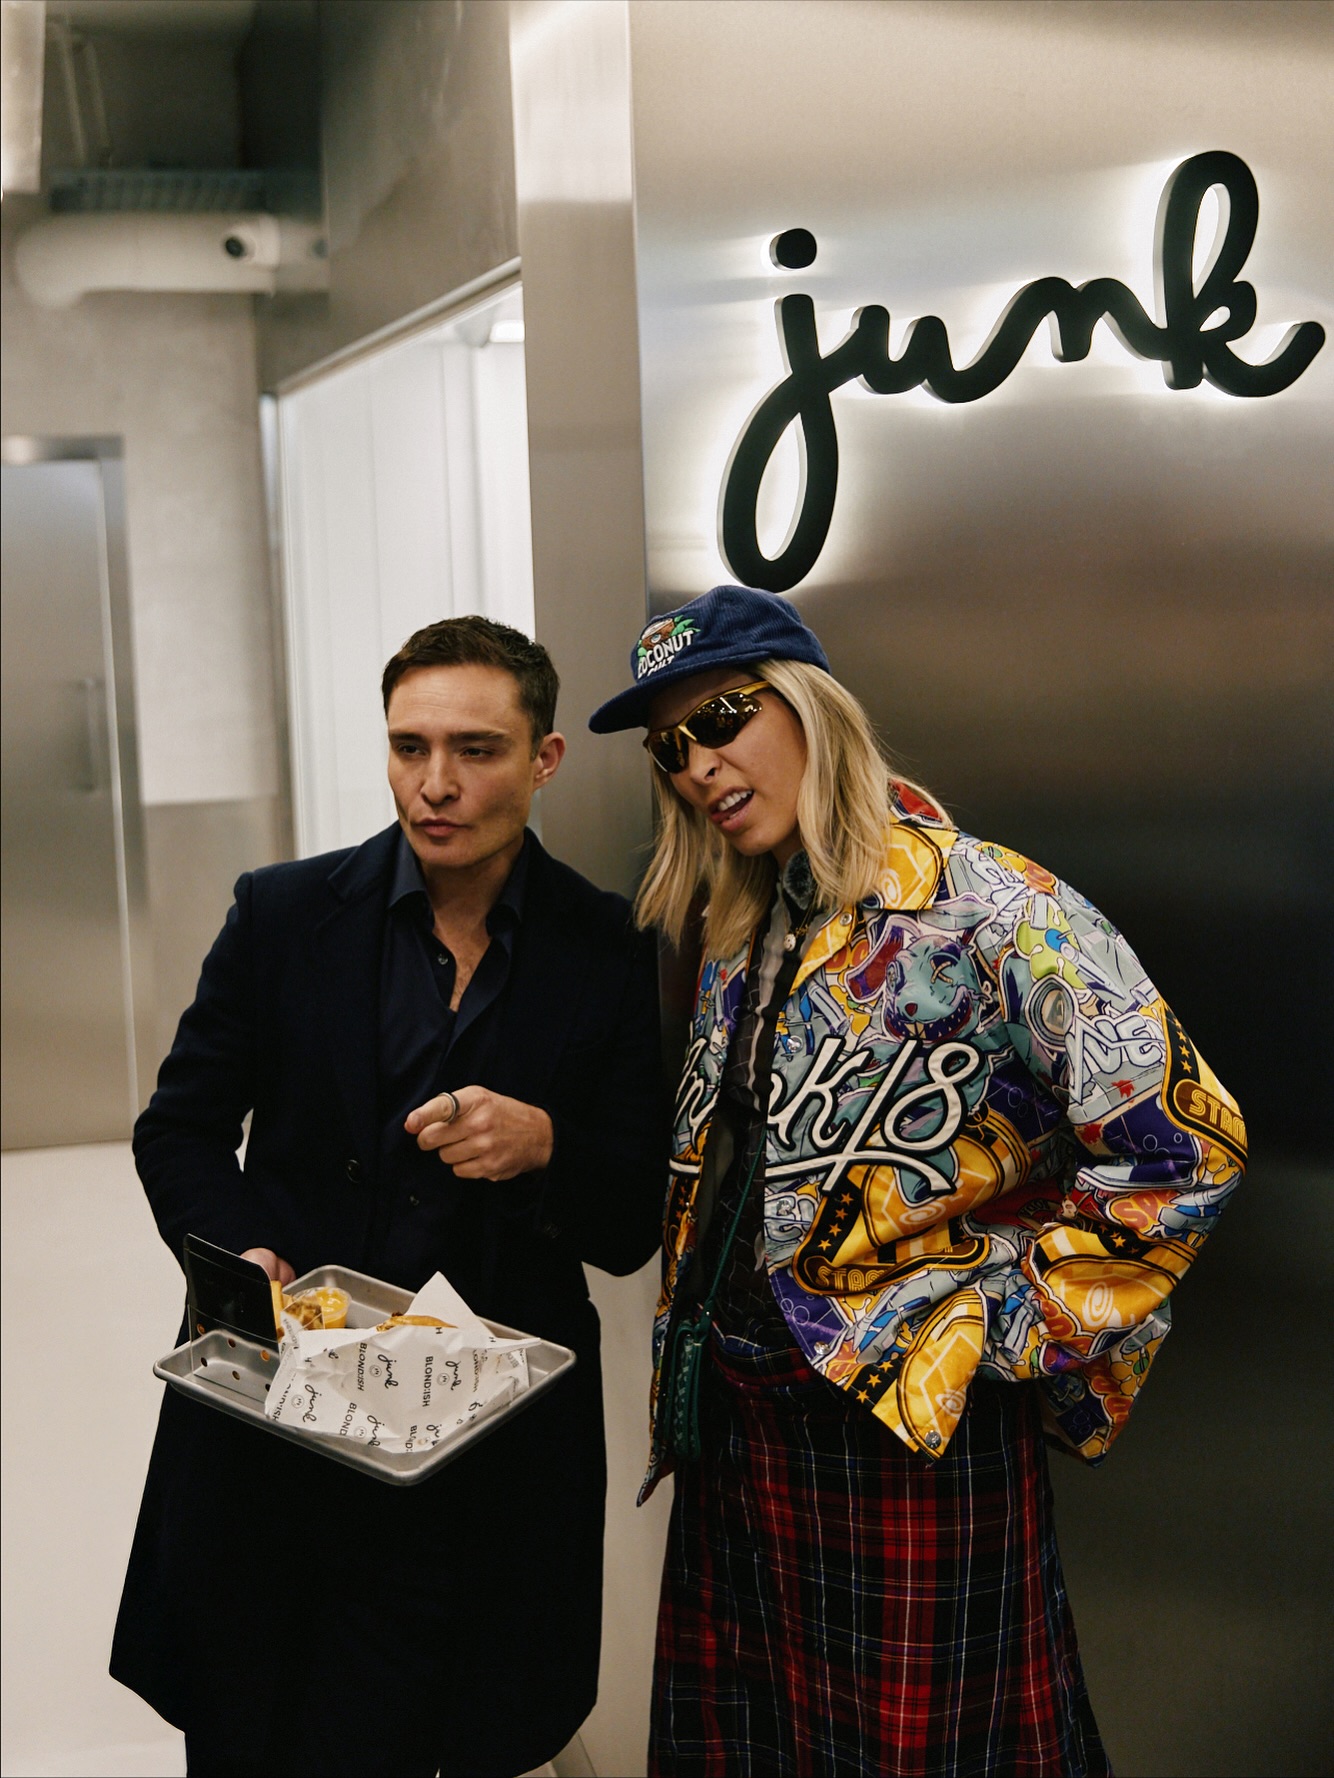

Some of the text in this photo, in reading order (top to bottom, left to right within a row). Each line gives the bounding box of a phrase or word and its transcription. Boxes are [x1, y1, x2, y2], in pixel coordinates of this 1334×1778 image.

[717, 151, 1325, 593] junk
[357, 1342, 368, 1392] BLOND:ISH
[377, 1354, 399, 1389] junk
[422, 1355, 434, 1408] BLOND:ISH
[445, 1360, 462, 1391] junk
[303, 1384, 322, 1423] junk
